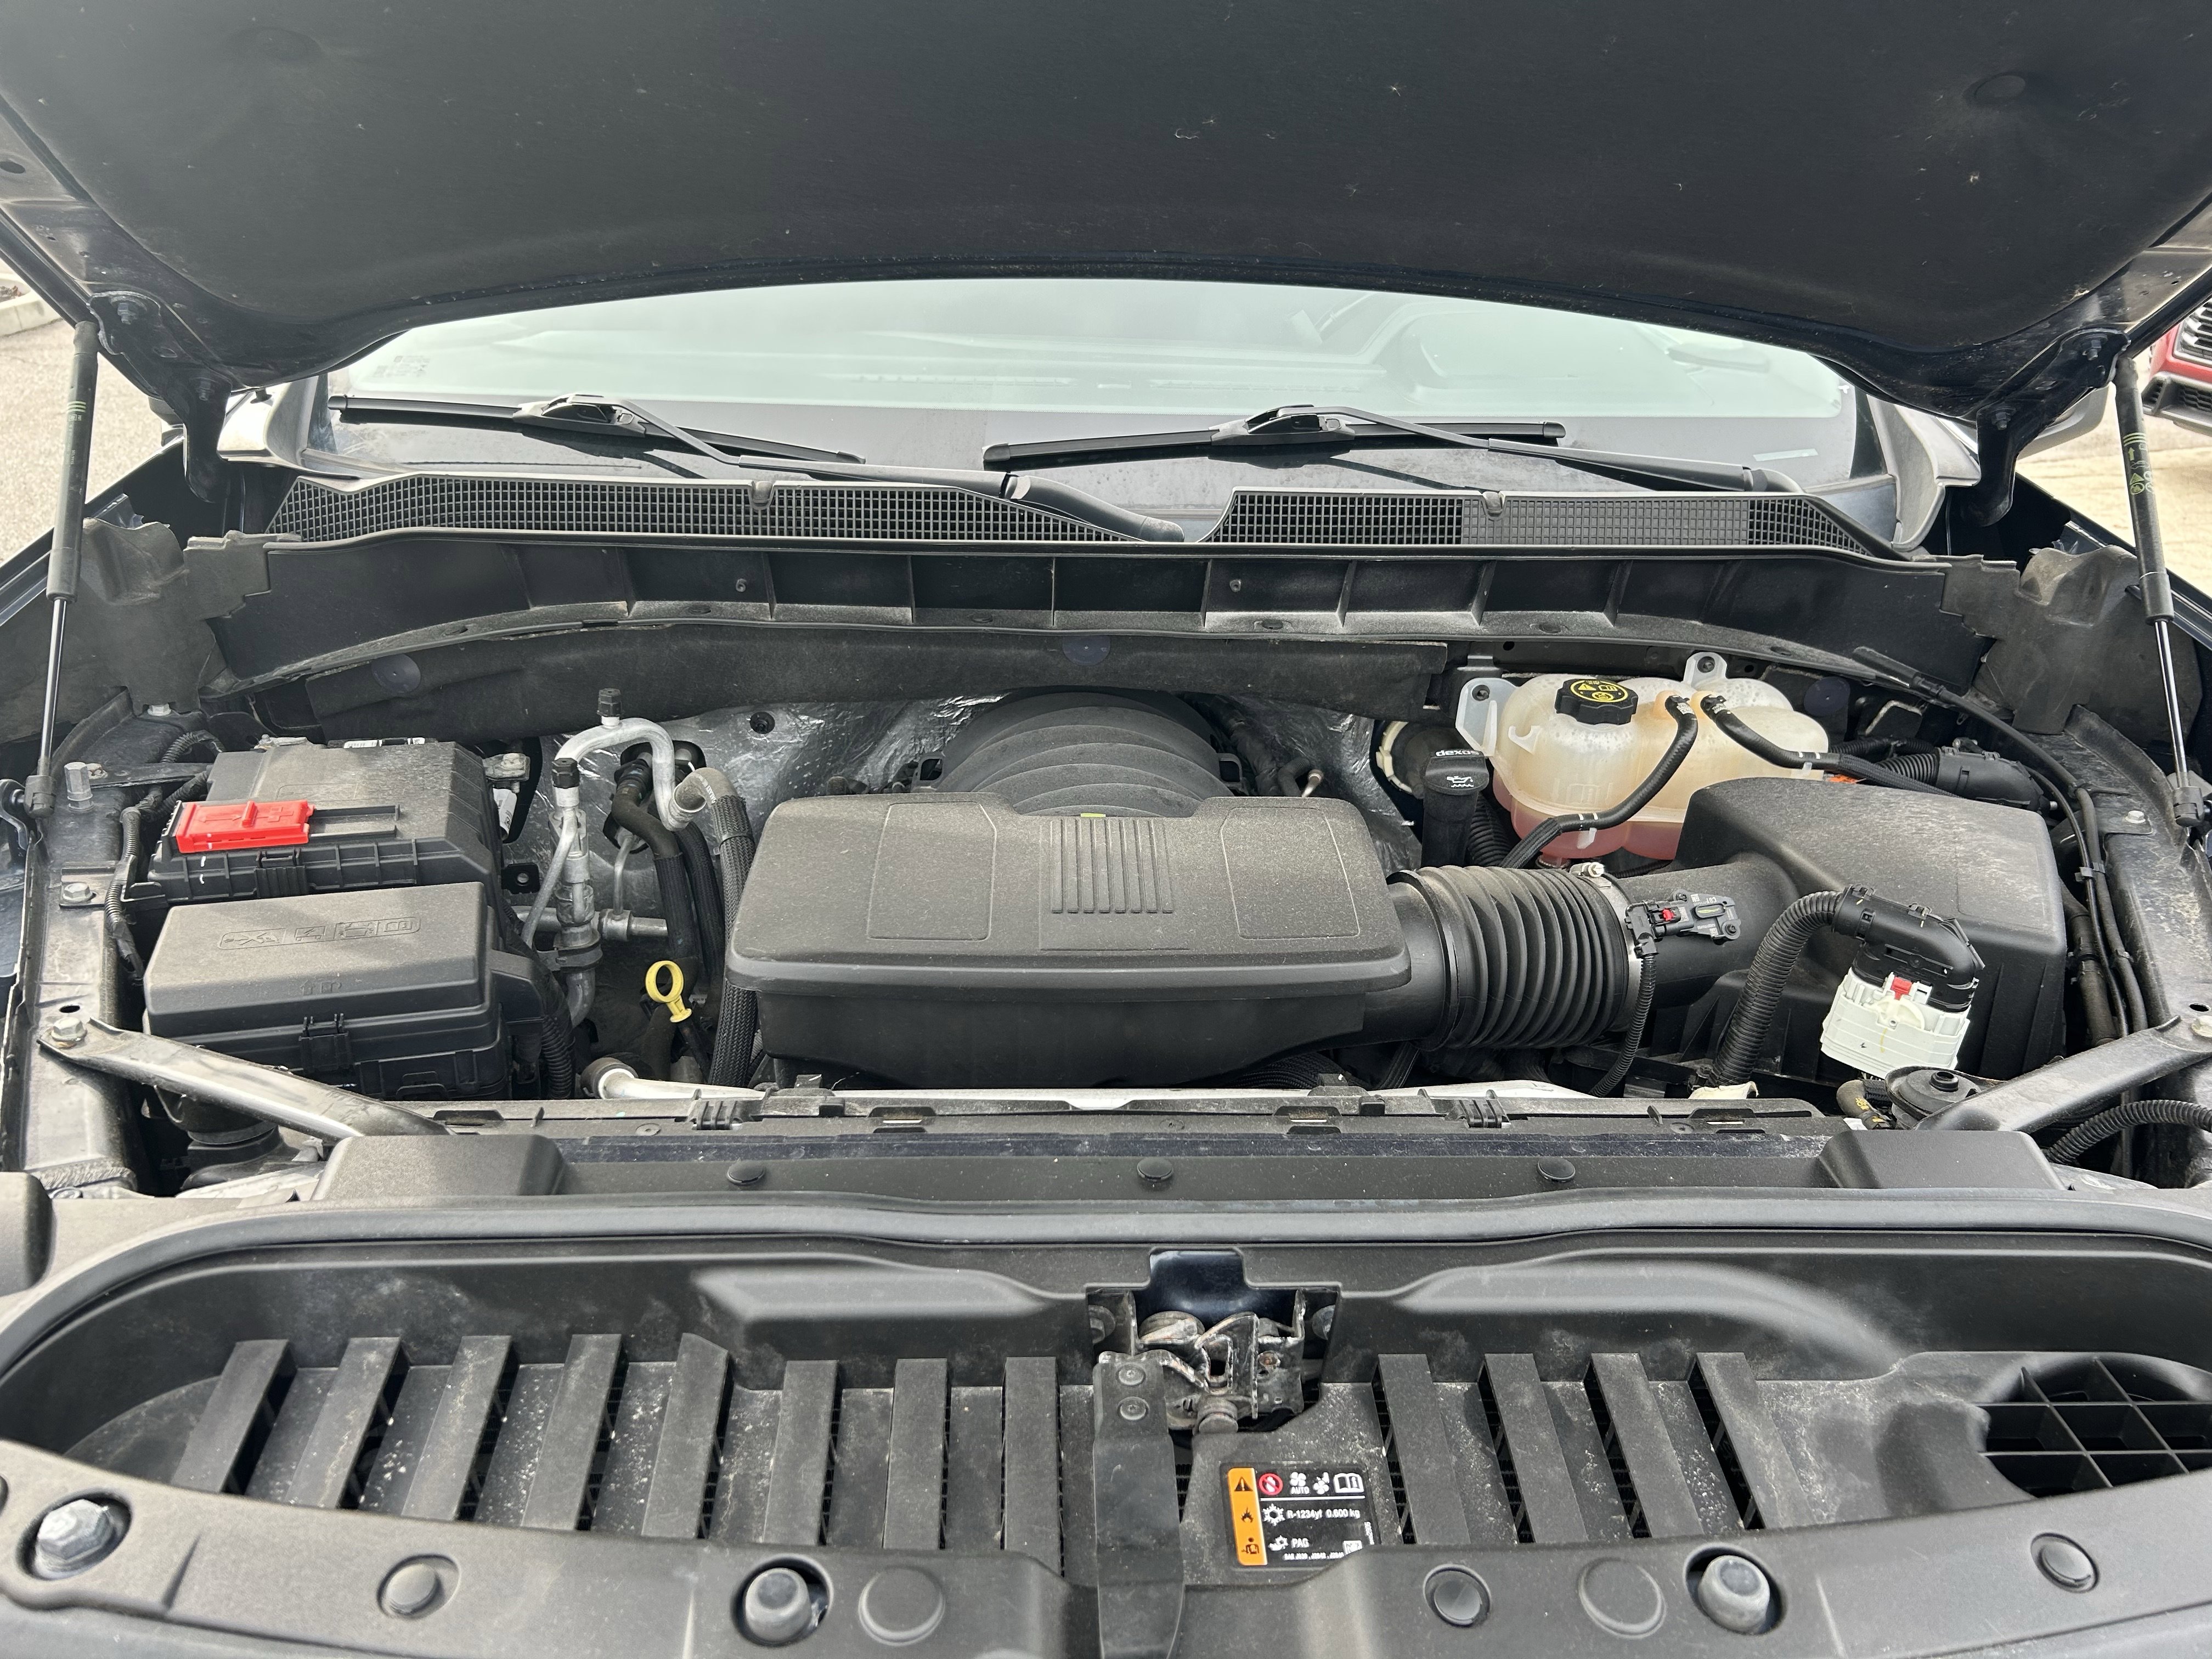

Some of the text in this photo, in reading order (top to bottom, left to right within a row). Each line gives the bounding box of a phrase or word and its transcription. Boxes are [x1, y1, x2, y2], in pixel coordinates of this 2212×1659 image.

[1291, 1486, 1310, 1494] AUTO
[1286, 1509, 1322, 1520] R-1234yf
[1349, 1508, 1361, 1519] kg
[1291, 1538, 1310, 1548] PAG
